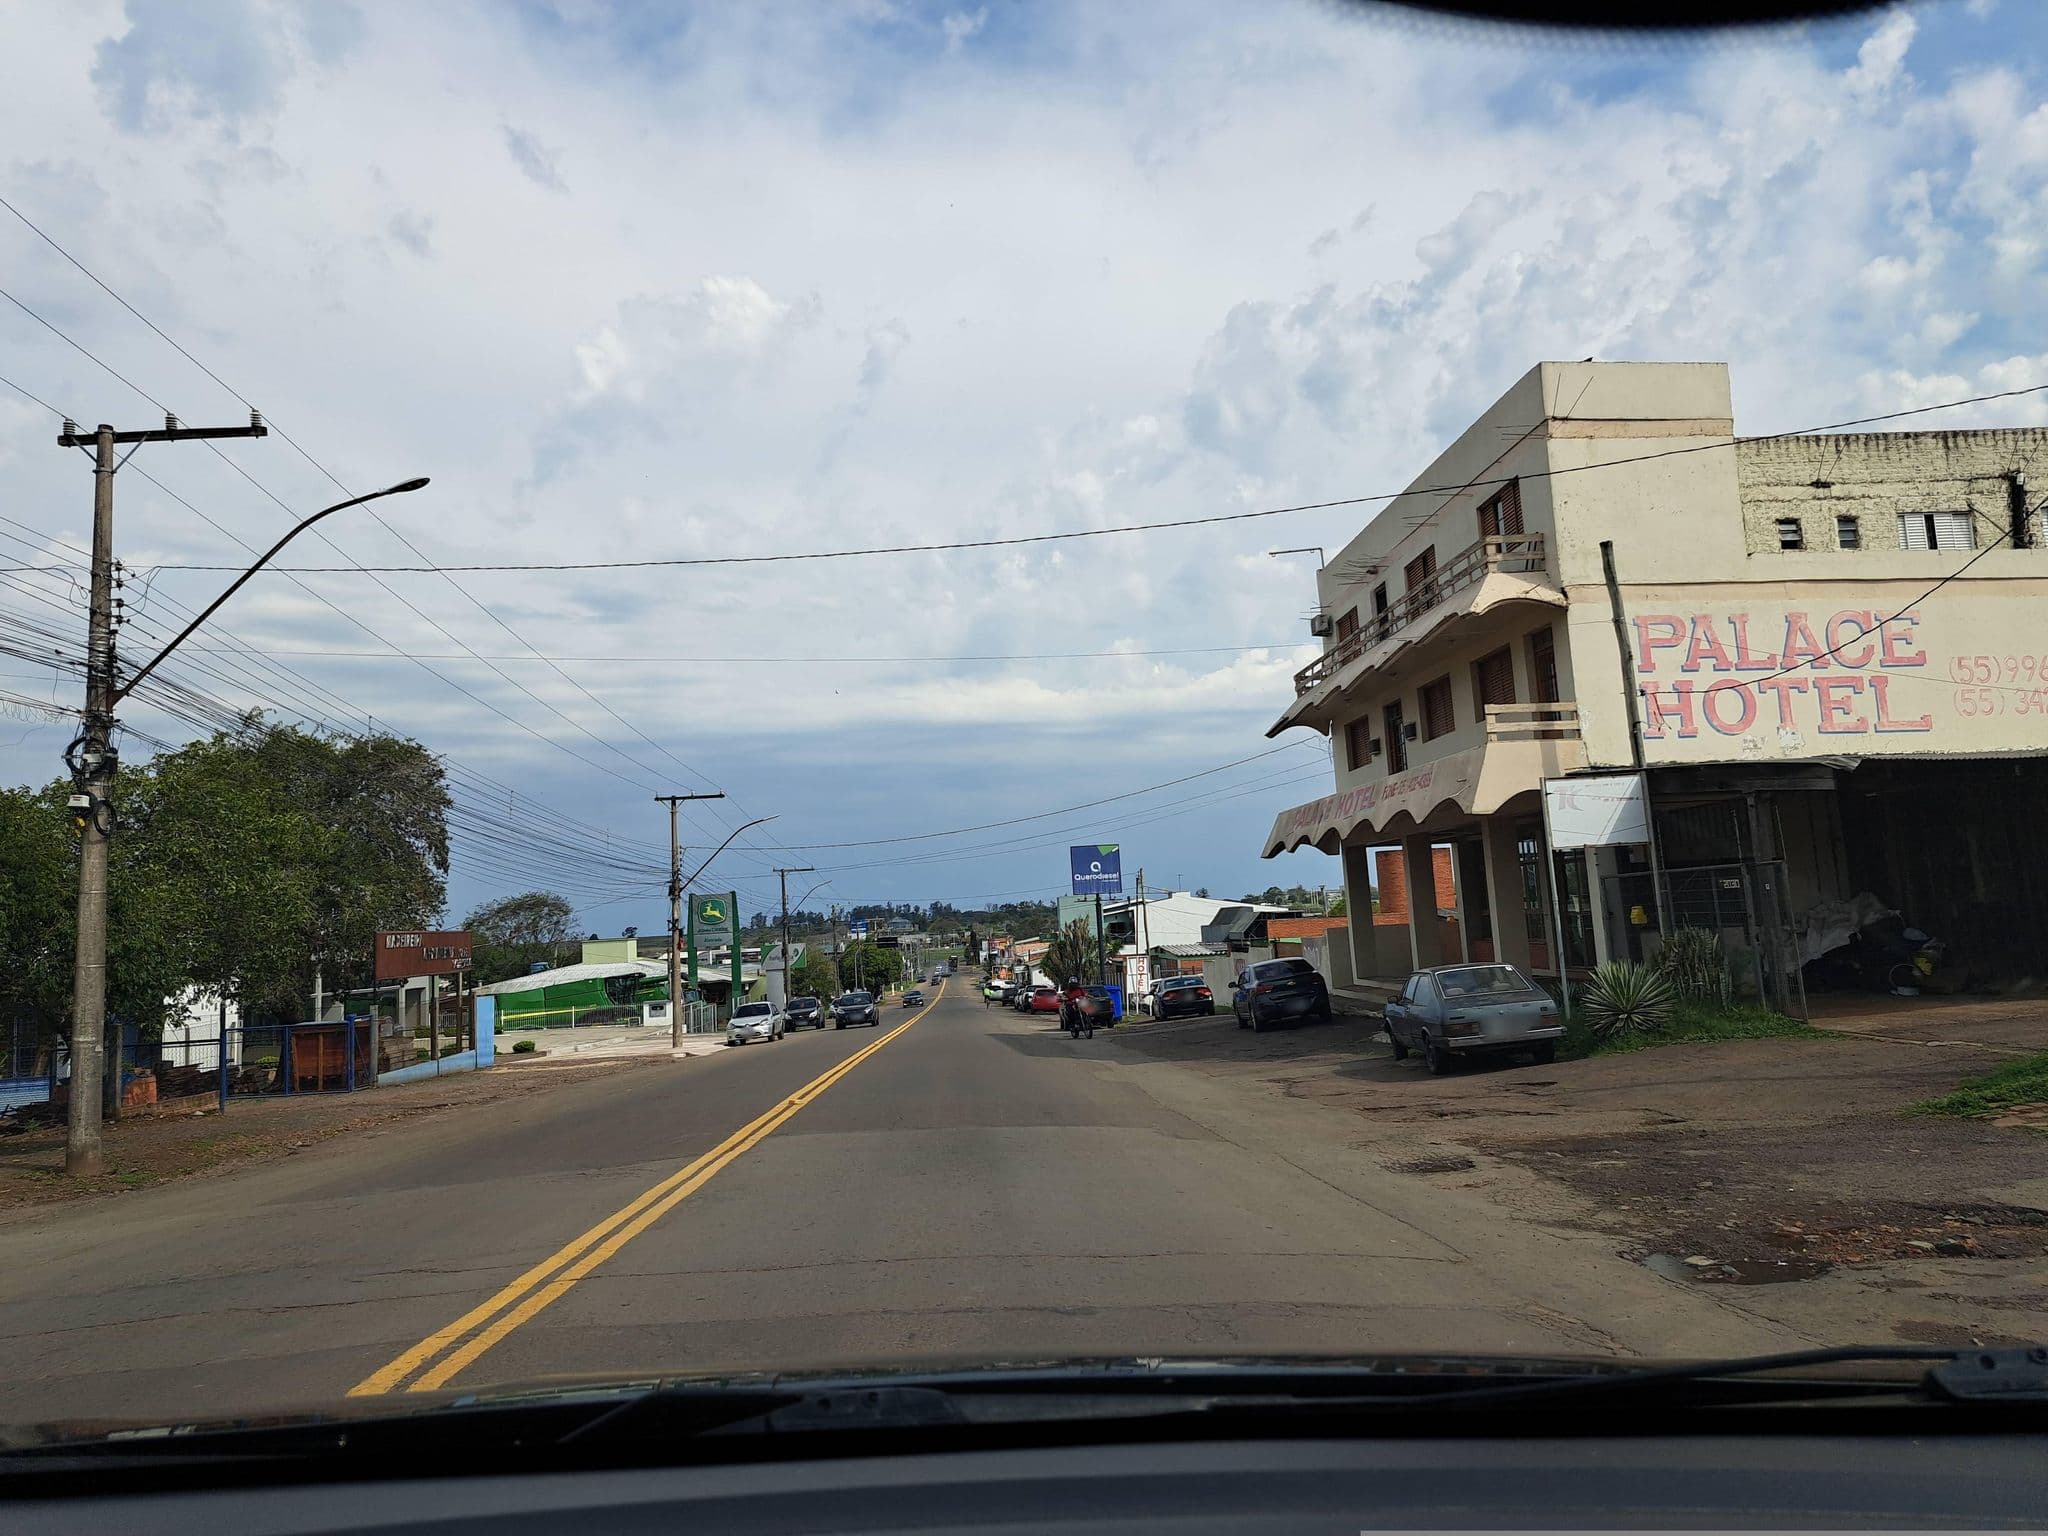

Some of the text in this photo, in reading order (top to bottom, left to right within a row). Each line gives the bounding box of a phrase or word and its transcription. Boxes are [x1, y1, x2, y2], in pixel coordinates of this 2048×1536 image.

[1634, 609, 1927, 673] PALACE
[1639, 675, 1933, 740] HOTEL
[1074, 871, 1119, 881] Querodiesel
[1137, 957, 1145, 992] HOTEL
